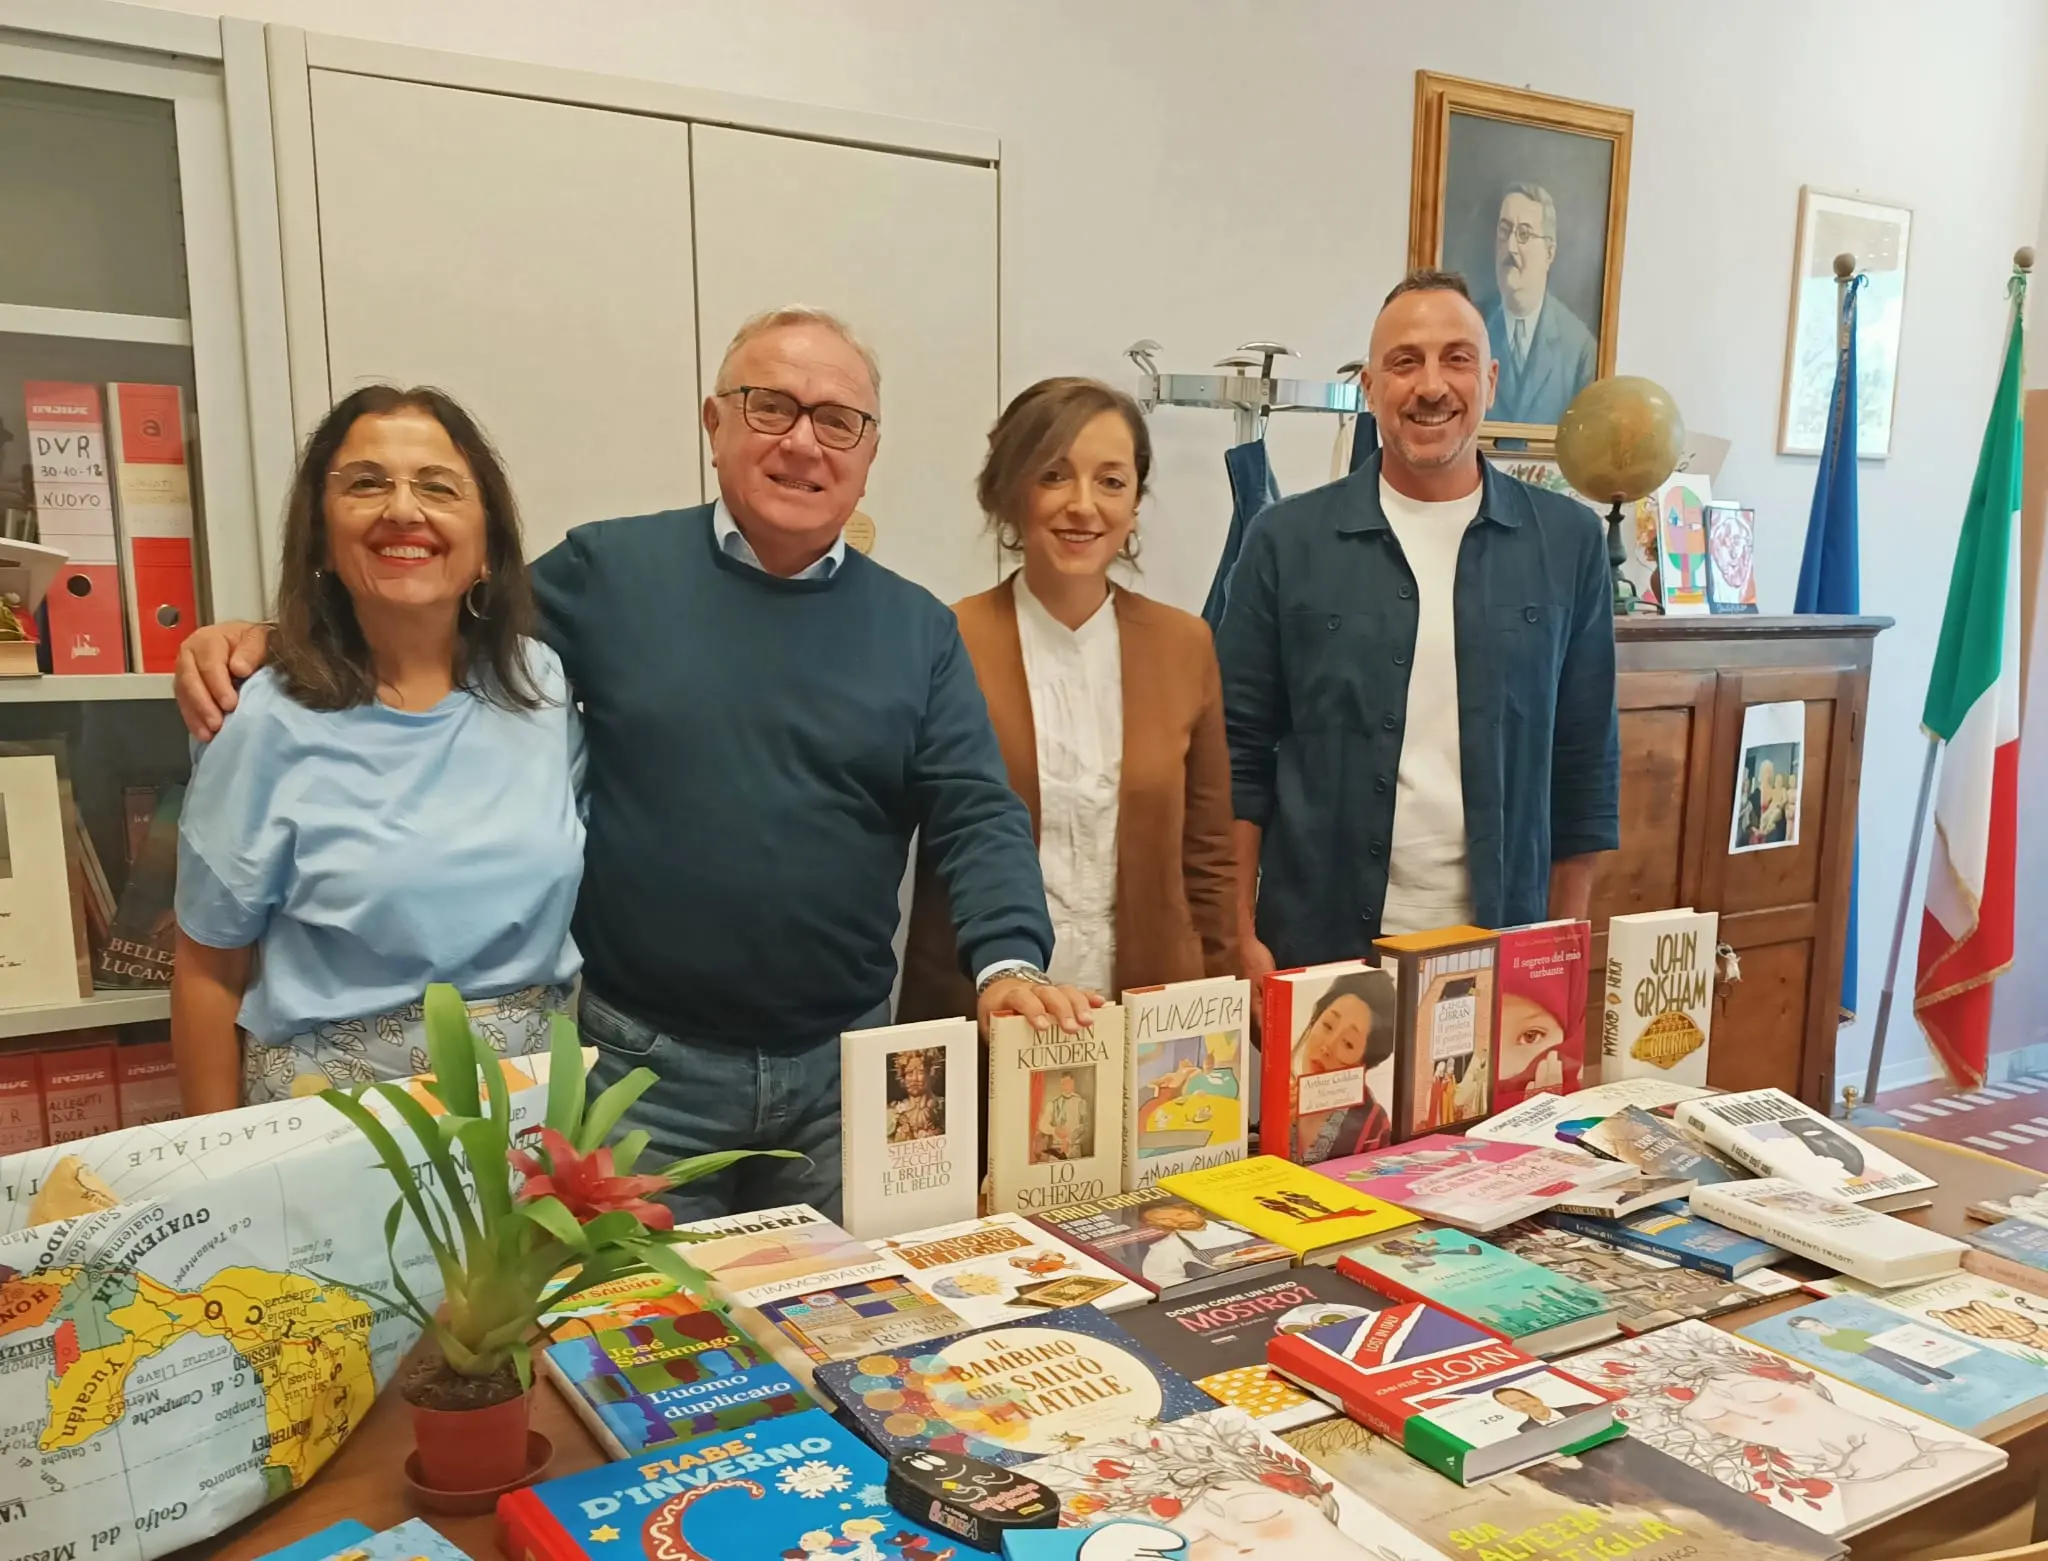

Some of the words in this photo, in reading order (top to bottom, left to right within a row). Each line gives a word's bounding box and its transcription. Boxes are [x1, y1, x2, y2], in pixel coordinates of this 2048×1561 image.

[37, 435, 90, 459] DVR
[43, 492, 101, 507] NUOVO
[1521, 956, 1550, 970] segreto
[1551, 950, 1565, 962] del
[1650, 930, 1697, 975] JOHN
[1607, 958, 1622, 988] JOHN
[1634, 969, 1707, 1018] GRISHAM
[1137, 996, 1243, 1038] KUNDERA
[1603, 1010, 1619, 1057] GRISHAM
[1017, 1040, 1109, 1069] KUNDERA
[1707, 1098, 1809, 1126] KUNDERA
[129, 1115, 303, 1168] GLACIALE
[888, 1138, 947, 1157] STEFANO
[883, 1171, 895, 1183] IL
[899, 1161, 952, 1181] BRUTTO
[891, 1149, 943, 1169] ZECCHI
[1050, 1163, 1075, 1185] LO
[884, 1184, 891, 1196] E
[896, 1182, 908, 1194] IL
[912, 1174, 951, 1192] BELLO
[1017, 1178, 1103, 1210] SCHERZO
[1039, 1203, 1103, 1224] CARLO
[1097, 1187, 1172, 1210] CRACCO
[92, 1208, 211, 1303] GUATEMALA
[895, 1227, 1018, 1260] DIPINGERE
[918, 1255, 945, 1267] IL
[942, 1238, 1022, 1262] LEGNO
[1772, 1229, 1821, 1253] TESTAMENTI
[1822, 1248, 1855, 1266] TRADITI
[1165, 1302, 1208, 1318] DORMI
[1208, 1292, 1244, 1307] COME
[1246, 1288, 1264, 1299] UN
[1264, 1281, 1297, 1294] VERO
[1176, 1286, 1318, 1332] MOSTRO?
[609, 1339, 666, 1360] José
[984, 1339, 1010, 1352] IL
[1365, 1336, 1384, 1353] LOST
[1381, 1314, 1399, 1332] ITALY
[616, 1333, 740, 1369] Saramago
[952, 1339, 1077, 1382] BAMBINO
[1412, 1346, 1520, 1386] SLOAN
[211, 1380, 224, 1395] di
[648, 1373, 748, 1405] L'uomo
[967, 1381, 1011, 1401] CHE
[1010, 1354, 1103, 1392] SALVÒ
[62, 1357, 125, 1438] Yucatán
[131, 1388, 204, 1426] Campeche
[663, 1379, 792, 1420] duplicato
[1010, 1375, 1132, 1420] NATALE
[638, 1439, 754, 1481] FIABE
[579, 1437, 832, 1520] D'INVERNO
[134, 1501, 188, 1533] Golfo
[91, 1526, 121, 1552] del
[1449, 1521, 1508, 1551] SUA
